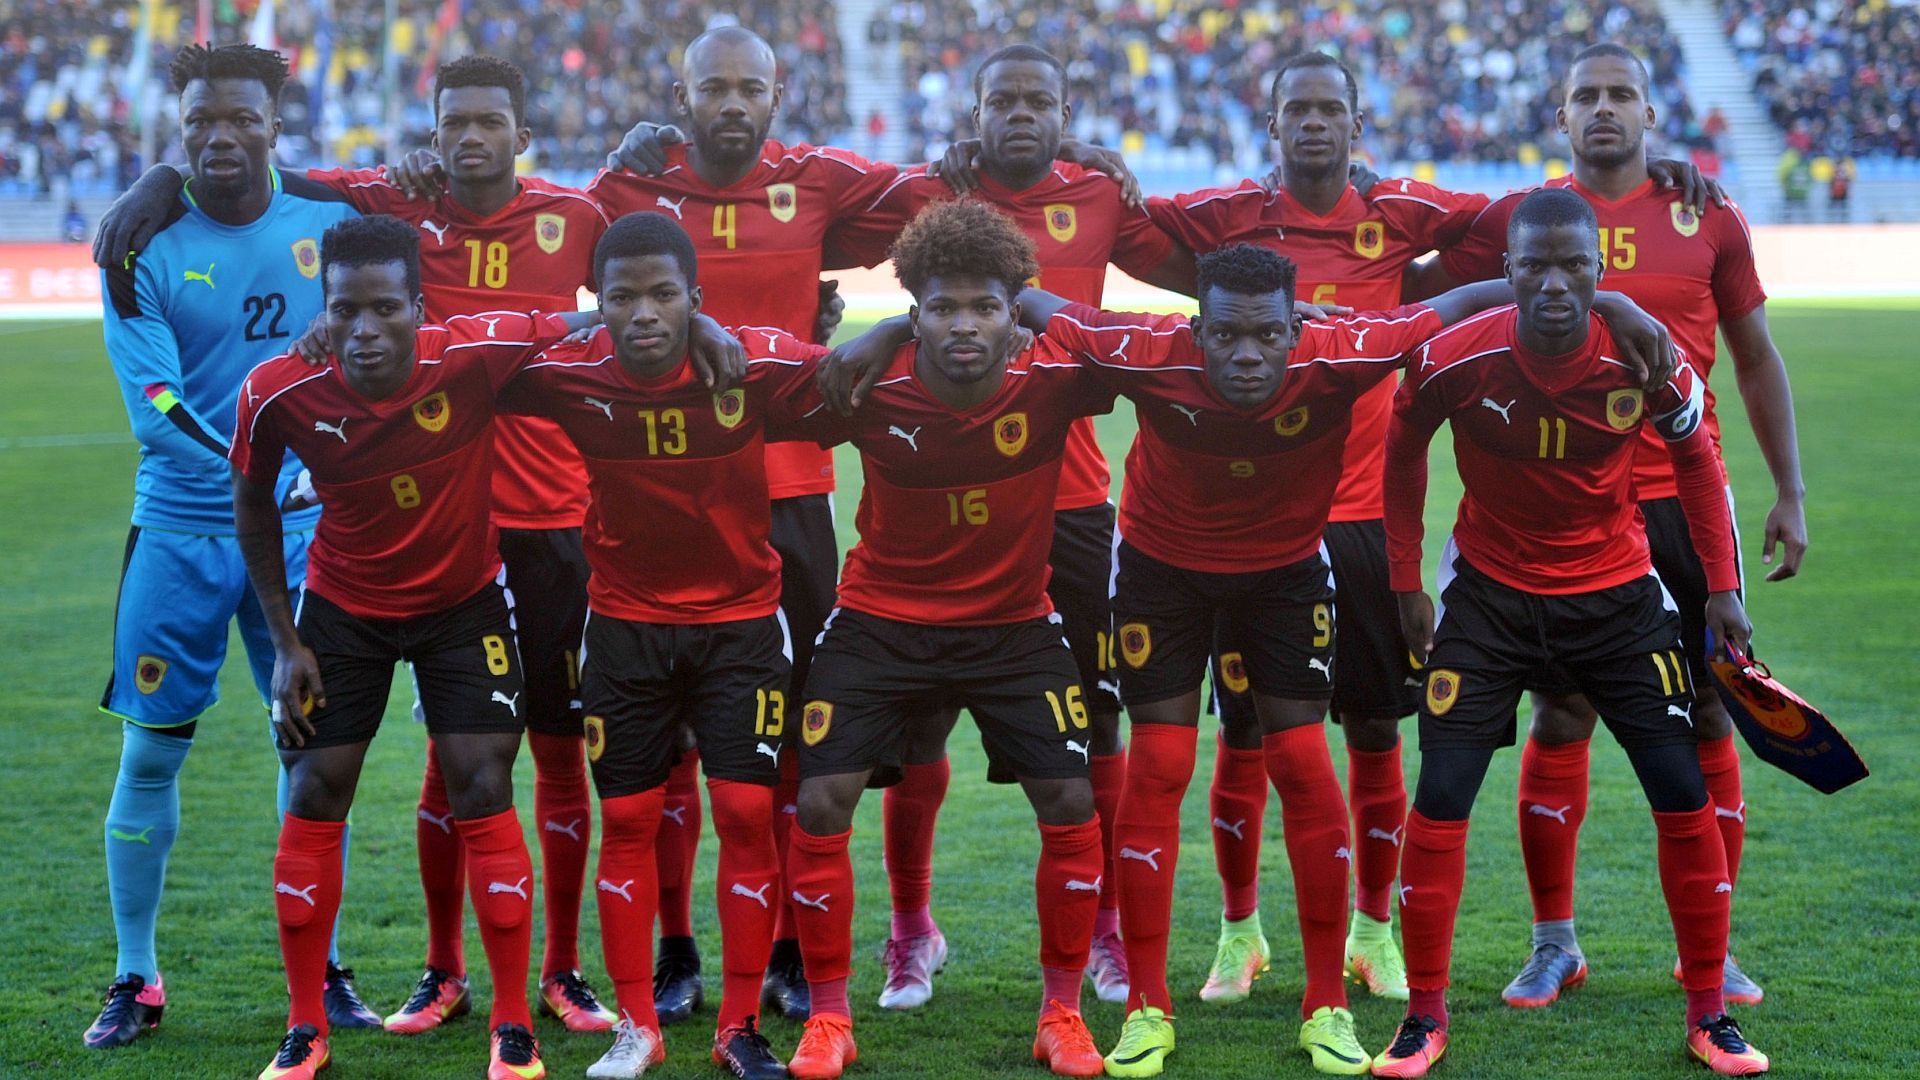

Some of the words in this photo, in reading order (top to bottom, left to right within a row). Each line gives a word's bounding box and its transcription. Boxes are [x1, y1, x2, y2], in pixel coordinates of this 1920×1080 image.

[713, 204, 736, 249] 4
[1598, 227, 1637, 270] 15
[465, 240, 509, 288] 18
[244, 293, 290, 343] 22
[638, 407, 688, 456] 13
[1538, 416, 1567, 460] 11
[391, 475, 421, 508] 8
[1230, 461, 1255, 478] 9
[948, 490, 989, 525] 16
[1312, 603, 1331, 648] 9
[482, 633, 511, 677] 8
[1654, 650, 1687, 697] 11
[754, 687, 786, 737] 13
[1045, 683, 1089, 734] 16
